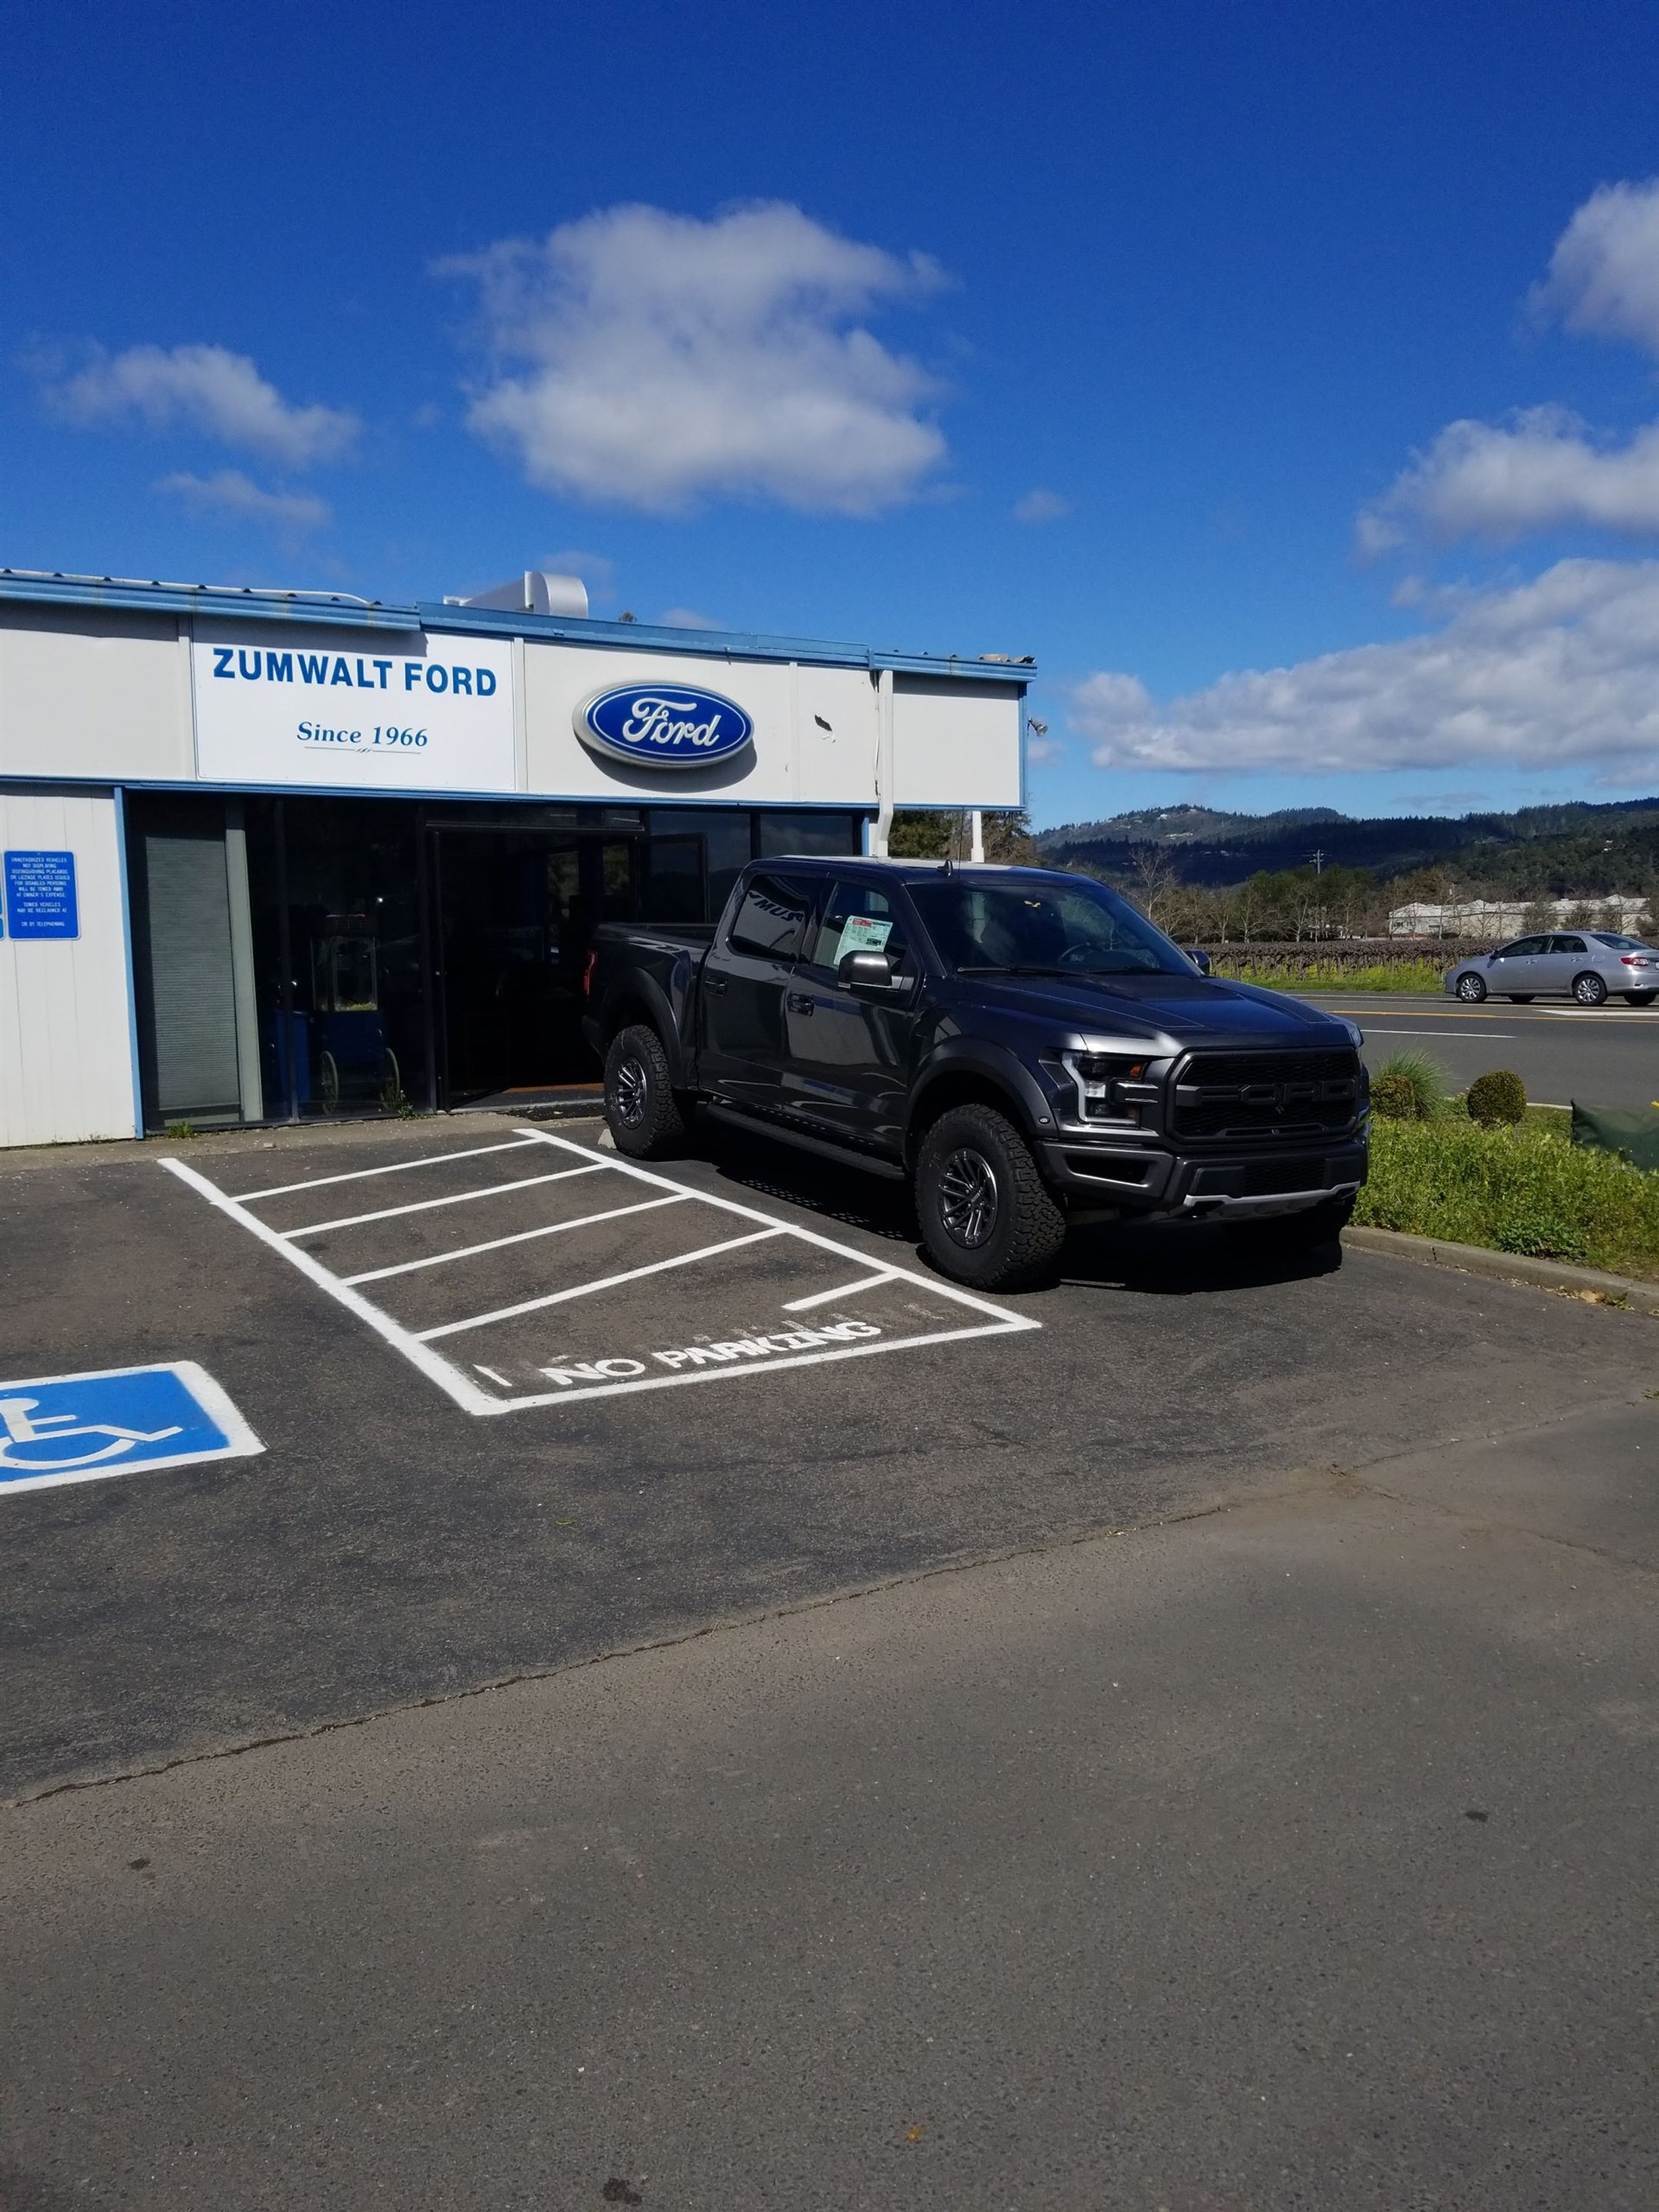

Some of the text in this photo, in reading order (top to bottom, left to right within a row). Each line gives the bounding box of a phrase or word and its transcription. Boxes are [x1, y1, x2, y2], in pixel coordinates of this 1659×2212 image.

[213, 648, 497, 696] ZUMWALT FORD
[296, 721, 429, 747] Since 1966
[622, 697, 721, 747] Ford
[539, 1321, 881, 1384] NO PARKING
